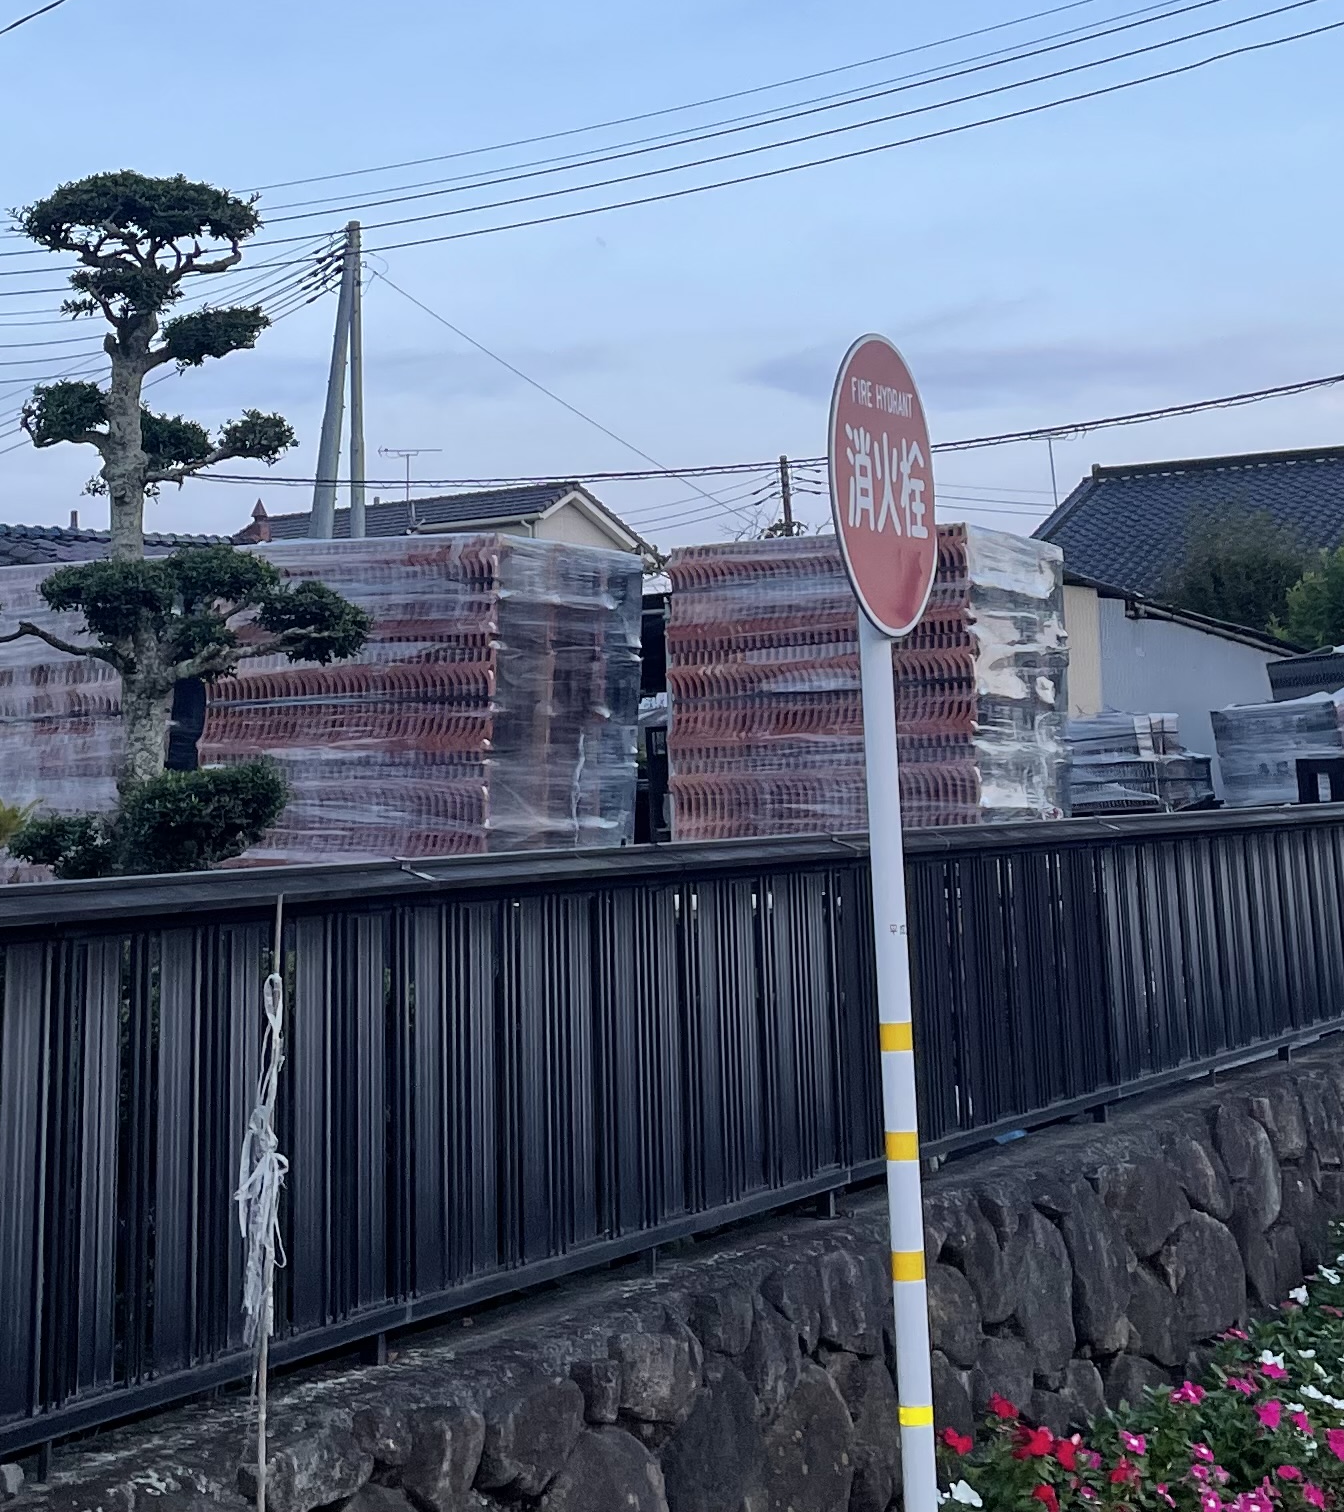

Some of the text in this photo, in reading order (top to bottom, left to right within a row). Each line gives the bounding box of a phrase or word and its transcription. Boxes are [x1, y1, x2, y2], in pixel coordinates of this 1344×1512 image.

[851, 376, 913, 419] FIRE HYDRANT
[845, 422, 928, 539] 消火栓
